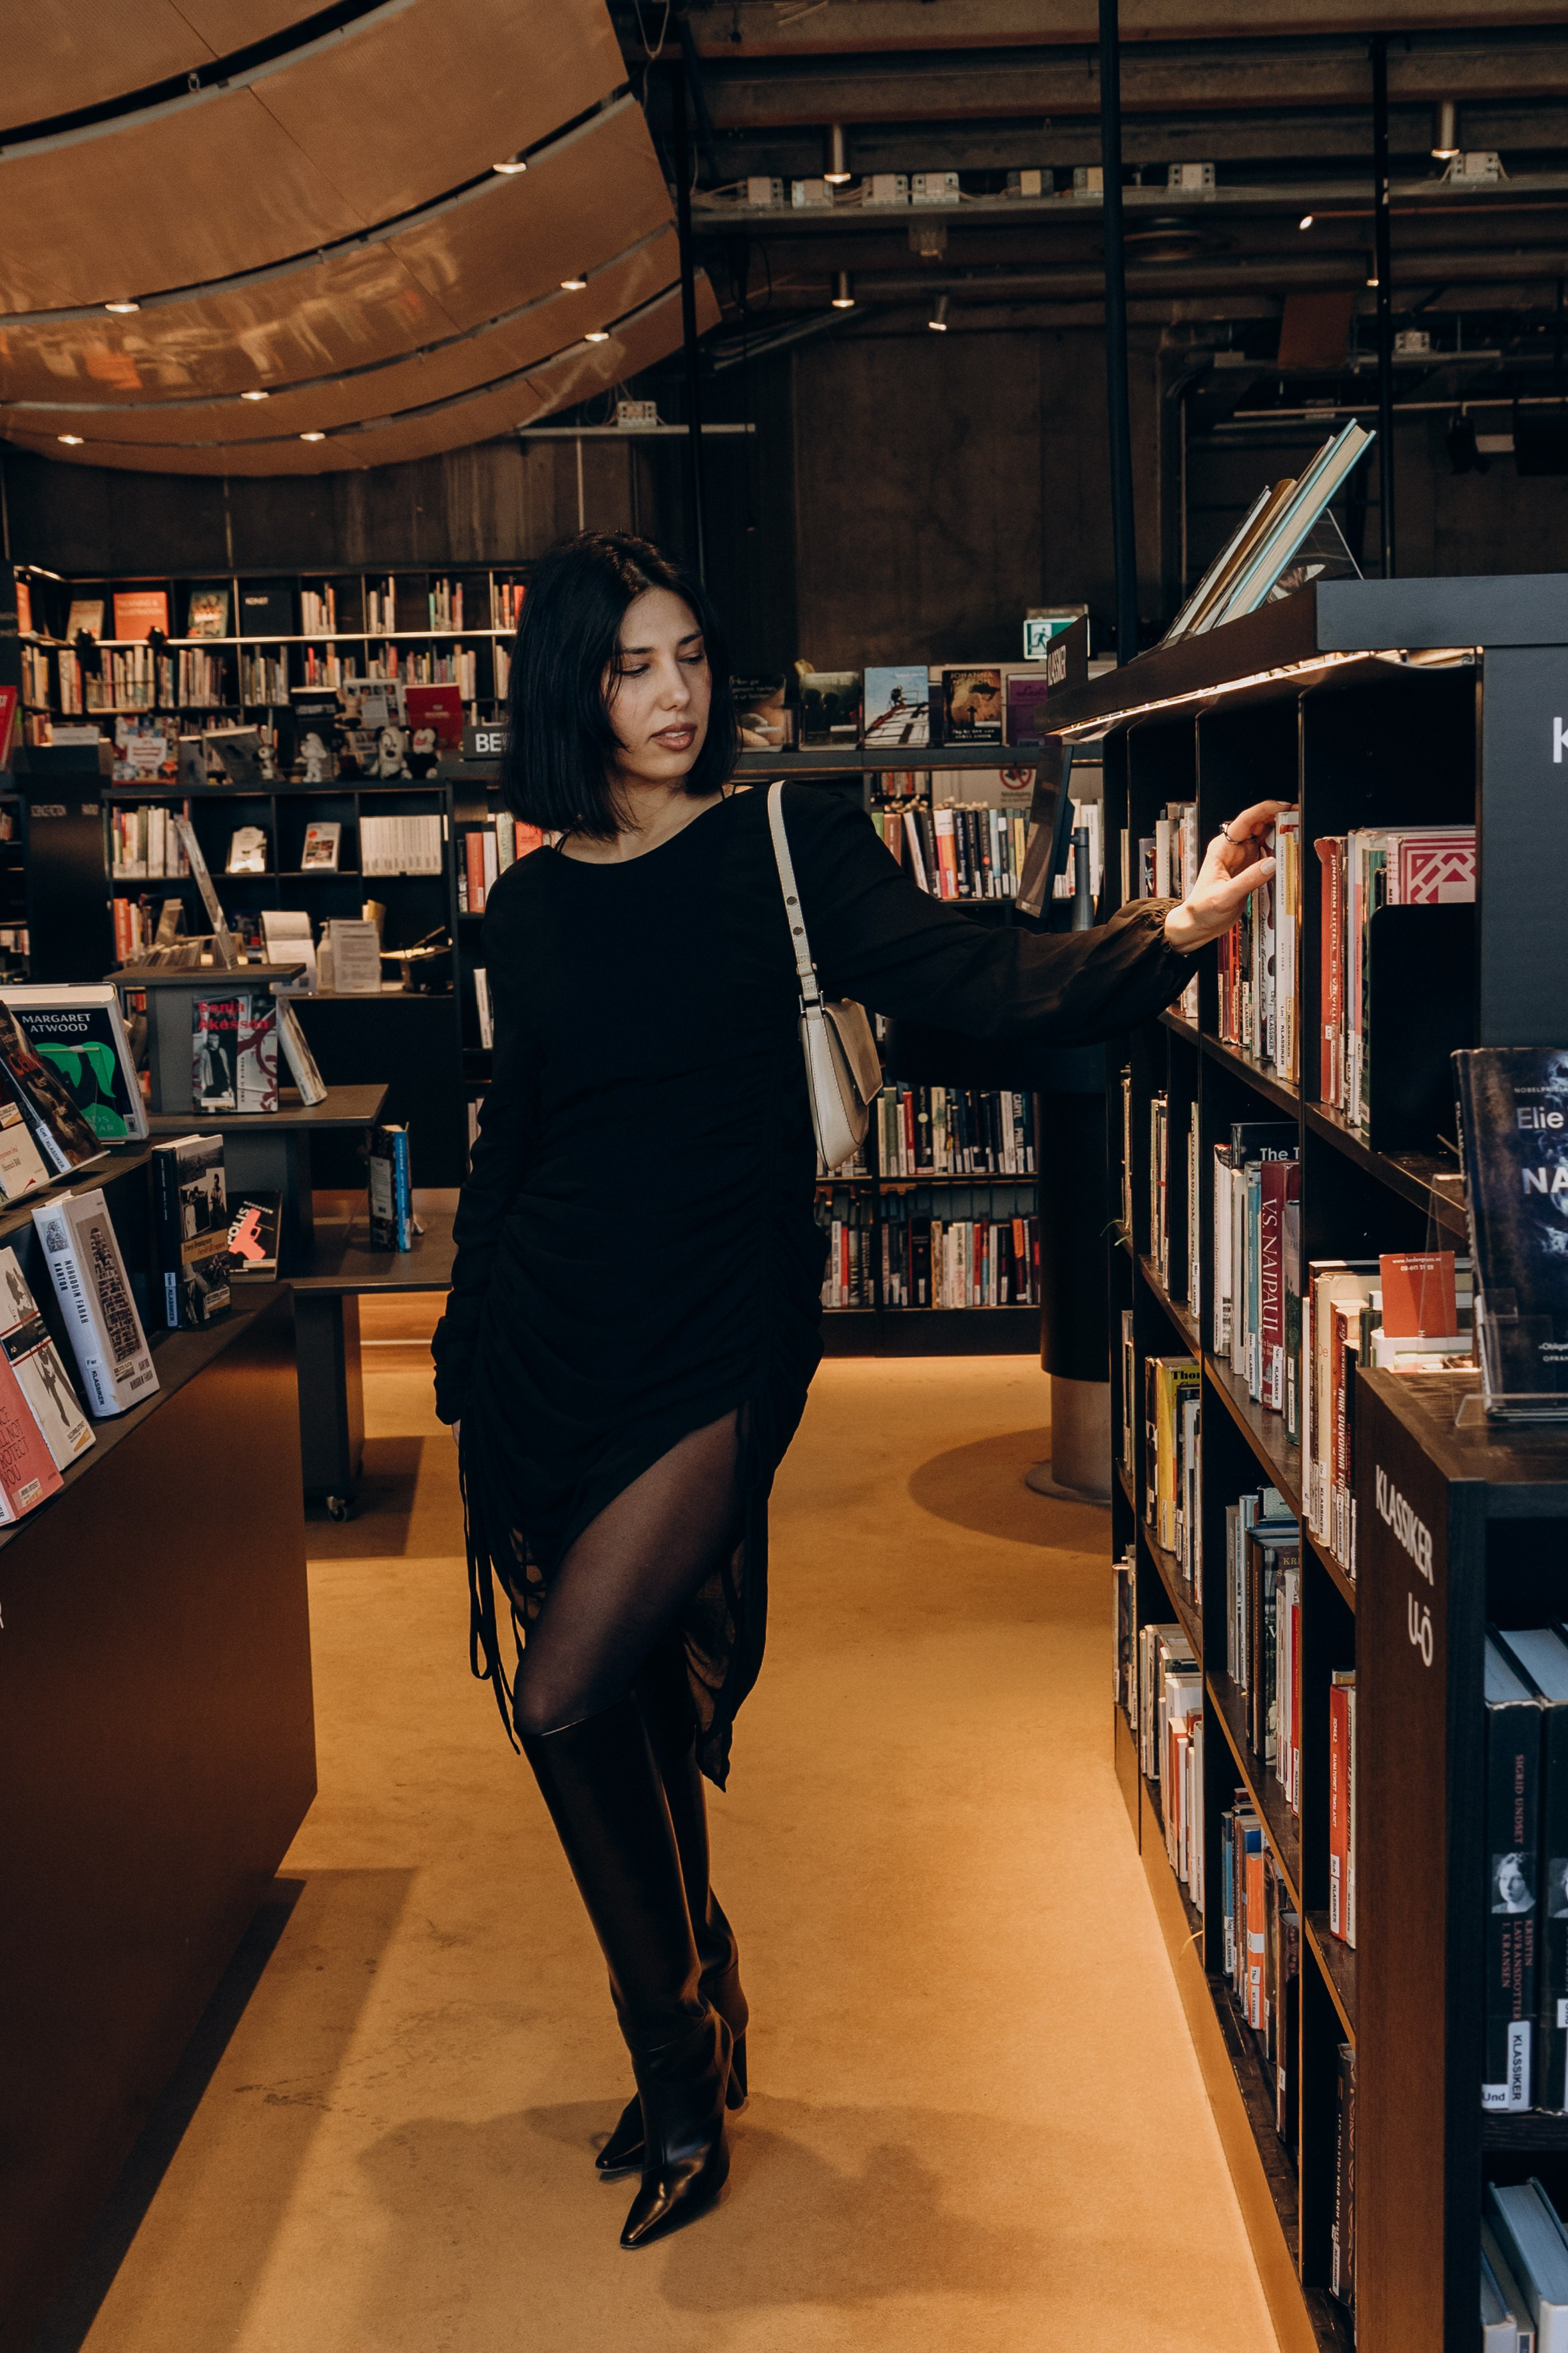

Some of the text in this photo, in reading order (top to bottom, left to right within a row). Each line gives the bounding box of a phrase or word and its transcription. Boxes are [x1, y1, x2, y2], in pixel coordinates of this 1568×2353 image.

[22, 1013, 91, 1024] MARGARET
[198, 1000, 245, 1014] Sonja
[30, 1023, 88, 1032] ATWOOD
[1013, 1094, 1022, 1118] CARYL
[1517, 1106, 1565, 1130] Elie
[45, 1140, 65, 1170] KLASSIKER
[1260, 1148, 1288, 1160] The
[54, 1262, 67, 1291] KARTOR
[1262, 1198, 1278, 1333] V.S. NAIPAUL
[65, 1260, 89, 1324] NURUDDIN FARAH
[91, 1370, 105, 1406] KLASSIKER
[0, 1437, 30, 1469] ROTECT
[1, 1465, 22, 1489] YOU
[1376, 1465, 1434, 1586] KLASSIKER
[1513, 1754, 1525, 1845] SIGRID UNDSET
[1525, 1919, 1533, 1967] KRISTIN
[1501, 1933, 1511, 1989] KRANSEN
[1513, 1921, 1523, 2021] LAVRANSDOTTER
[1511, 2035, 1523, 2102] KLASSIKER
[1483, 2092, 1505, 2103] Und
